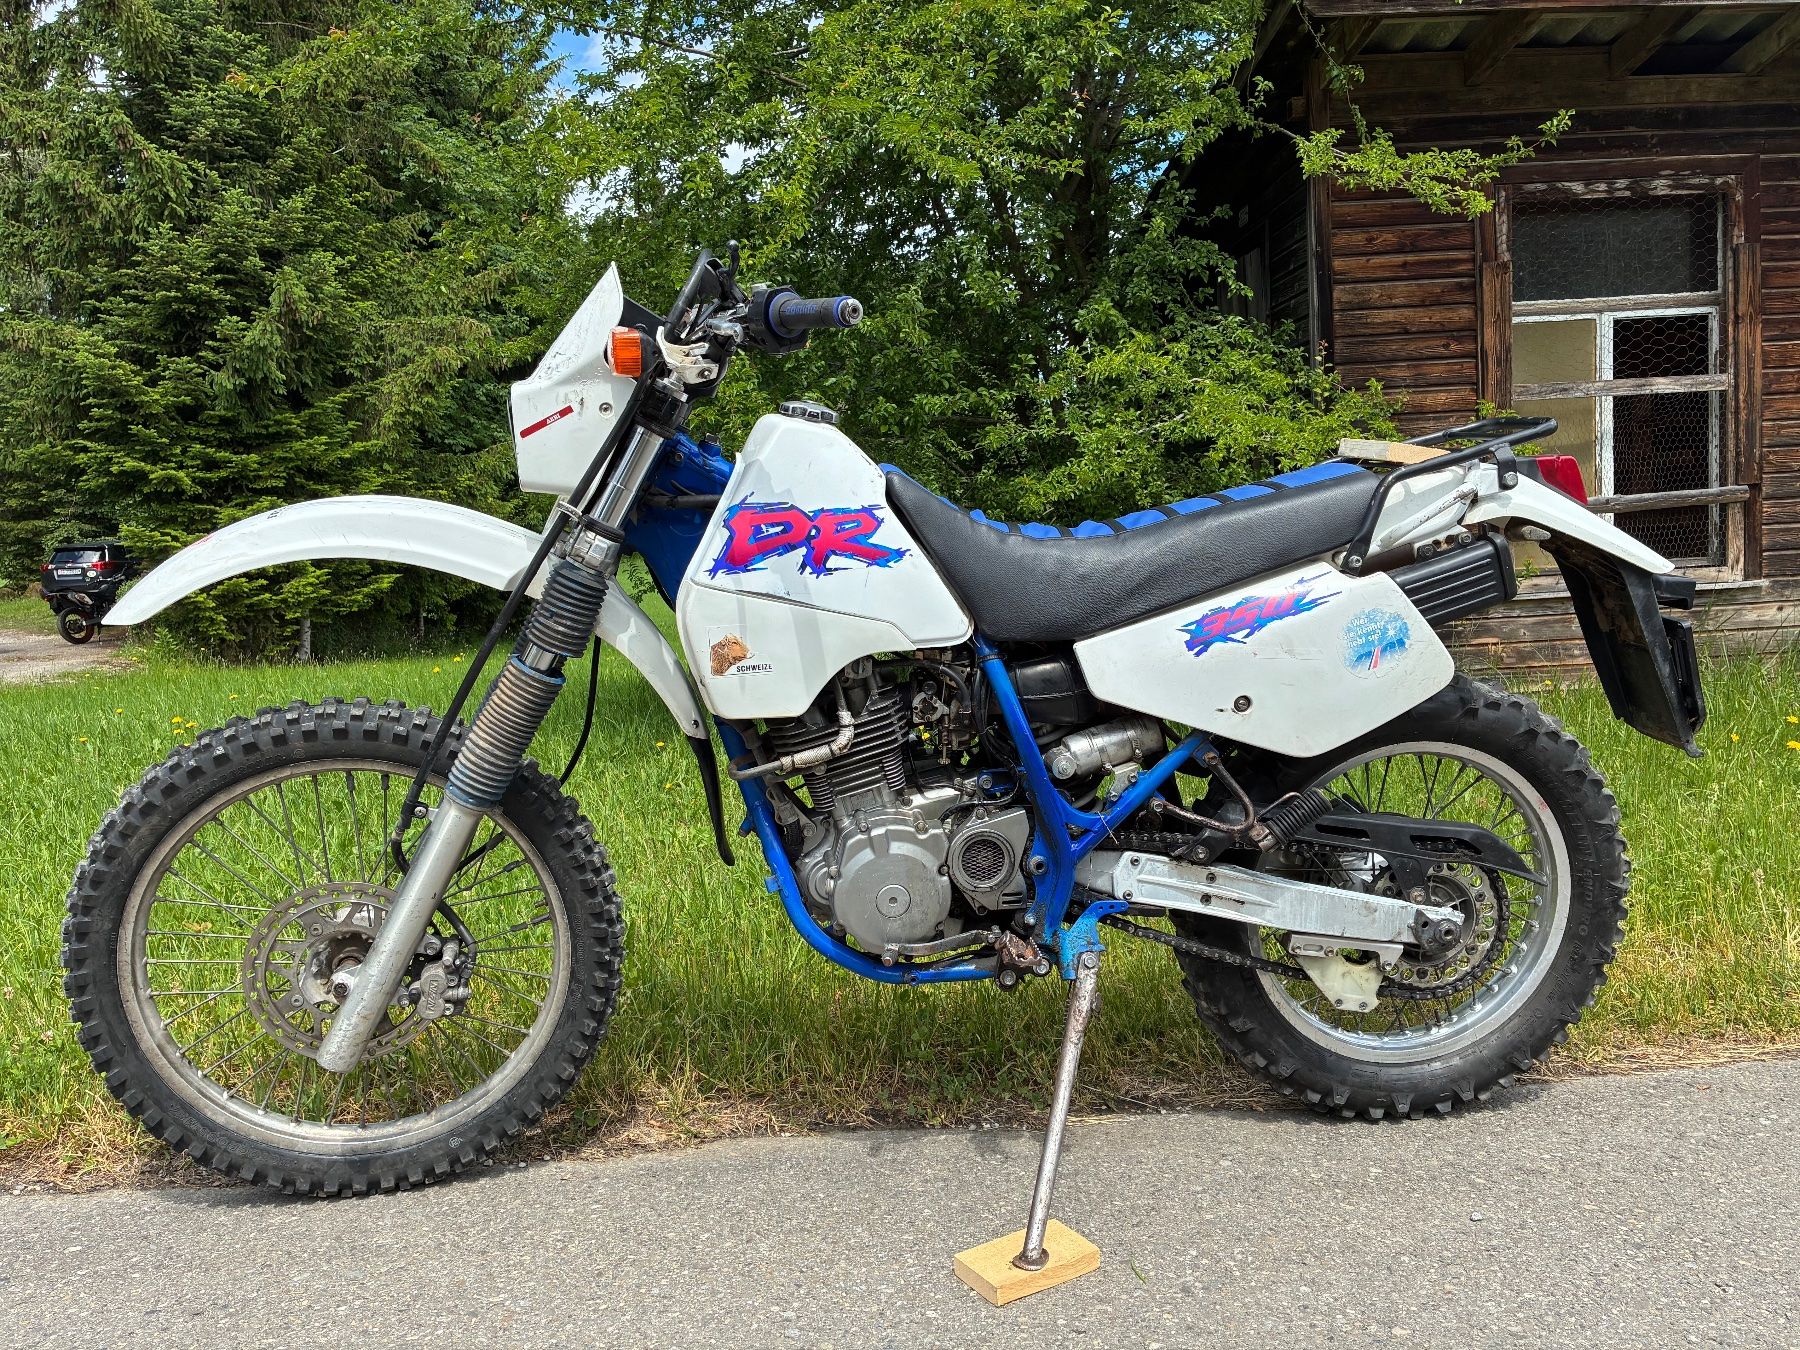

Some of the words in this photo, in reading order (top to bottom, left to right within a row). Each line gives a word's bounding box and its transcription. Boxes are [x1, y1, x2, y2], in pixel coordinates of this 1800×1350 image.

[716, 500, 902, 575] DR
[1188, 588, 1305, 650] 350
[1352, 616, 1369, 626] Wer
